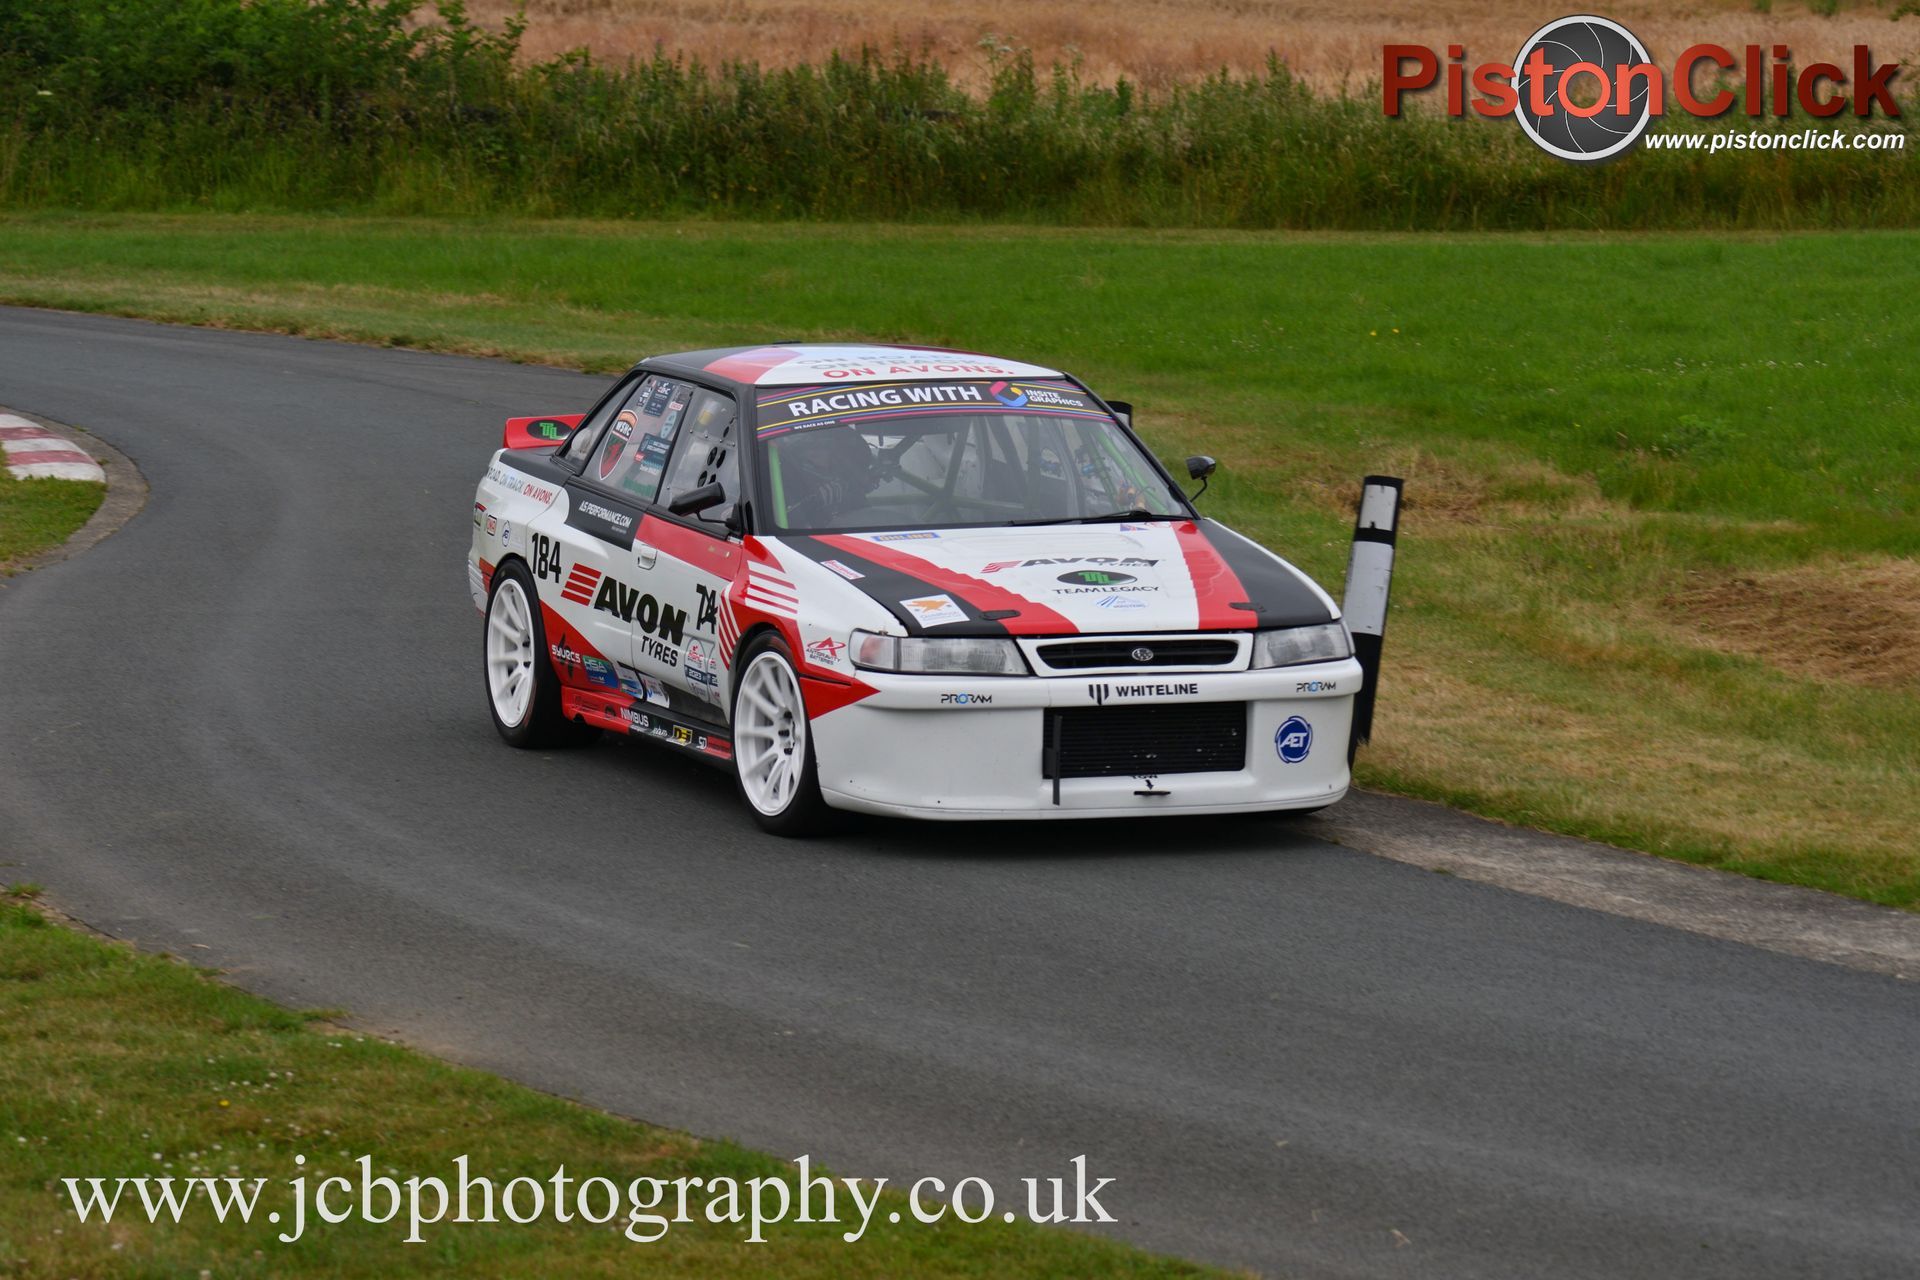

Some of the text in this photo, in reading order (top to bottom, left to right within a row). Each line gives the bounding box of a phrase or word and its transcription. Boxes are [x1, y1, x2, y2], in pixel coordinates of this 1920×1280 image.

[823, 365, 1014, 378] ON AVONS.
[788, 386, 982, 417] RACING WITH
[532, 532, 561, 583] 184
[594, 576, 687, 646] AVON
[641, 635, 678, 667] TYRES
[1115, 683, 1198, 697] WHITELINE
[1296, 681, 1336, 693] PRORAM
[941, 693, 992, 704] PRORAM
[620, 706, 649, 727] NIMBUS
